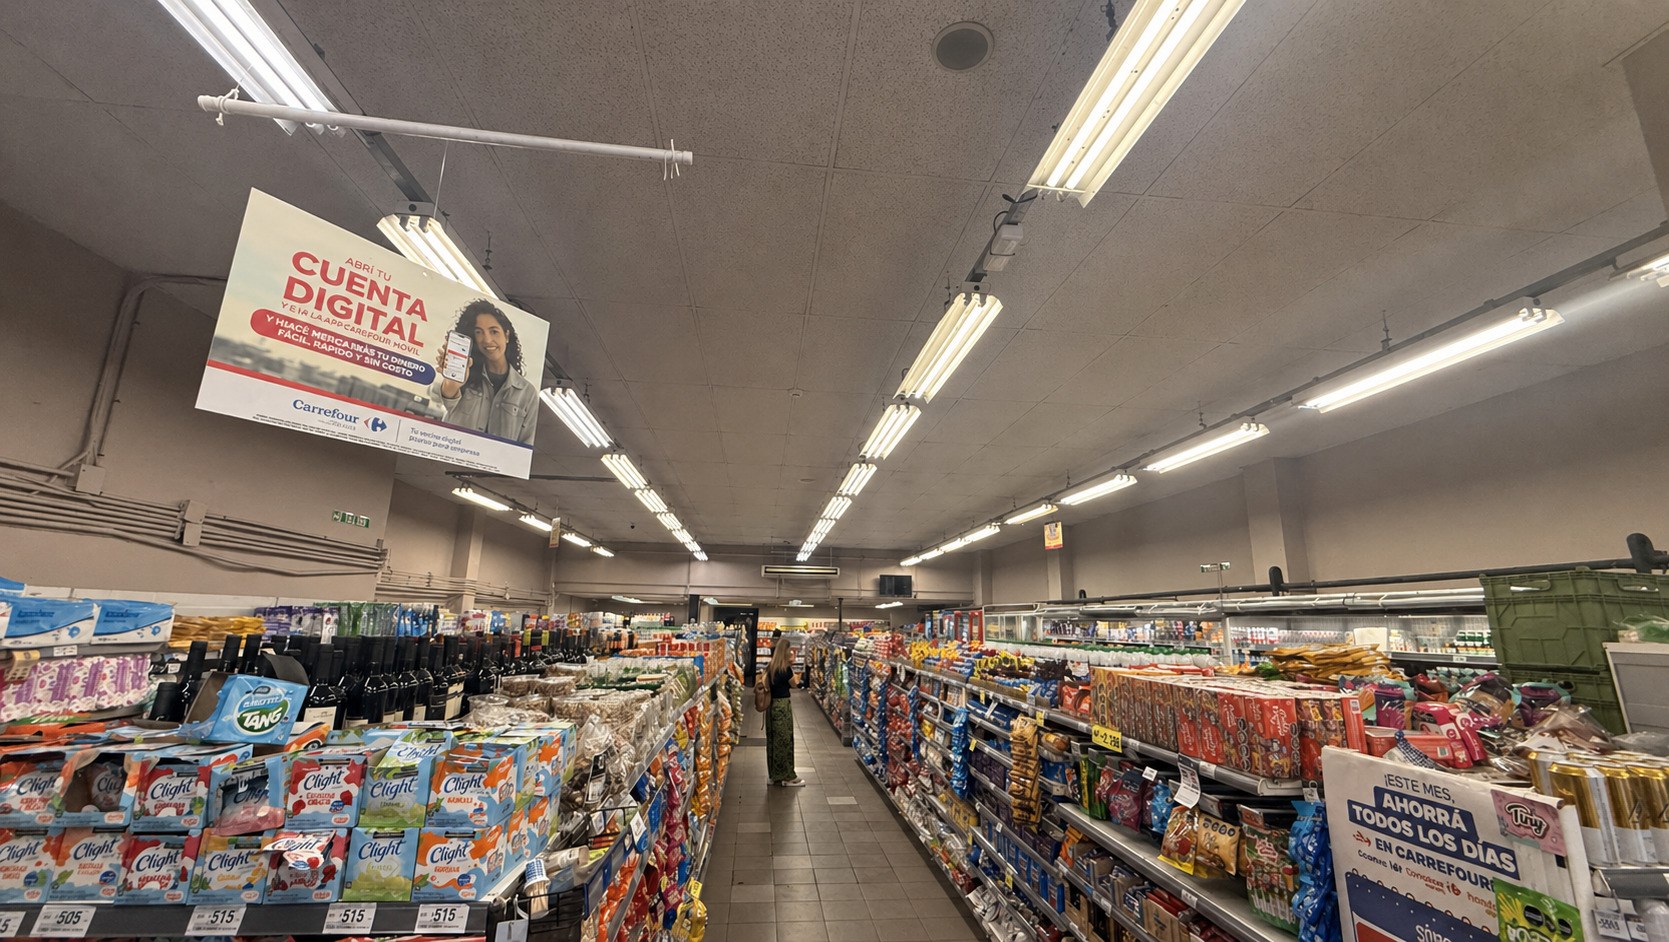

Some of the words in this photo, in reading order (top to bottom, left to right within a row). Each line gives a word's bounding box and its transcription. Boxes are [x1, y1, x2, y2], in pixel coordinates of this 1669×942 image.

[345, 258, 375, 275] ABRÍ
[376, 269, 392, 282] TU
[292, 252, 428, 322] CUENTA
[283, 276, 424, 348] DIGITAL
[265, 314, 274, 322] Y
[376, 350, 390, 364] TU
[354, 352, 363, 361] Y
[364, 356, 381, 368] SIN
[381, 360, 414, 378] COSTO
[292, 398, 360, 424] Carrefour
[242, 707, 283, 730] TANG
[16, 776, 56, 796] Cligh
[150, 778, 195, 800] Clight
[304, 770, 344, 790] Clight
[370, 777, 418, 800] Clight
[444, 774, 486, 795] Clight
[1384, 774, 1421, 793] ¡ESTE
[1422, 782, 1455, 804] MES,
[1382, 792, 1468, 833] AHORRÁ
[1506, 802, 1550, 837] Tiny
[73, 836, 118, 862] Clight
[358, 838, 407, 862] Clight
[1352, 804, 1414, 838] TODOS
[1417, 824, 1457, 853] LOS
[1461, 838, 1517, 874] DÍAS
[1374, 838, 1393, 855] EN
[136, 850, 181, 874] Clight
[208, 850, 252, 874] Clight
[430, 842, 470, 864] Clight
[57, 910, 83, 925] 505
[210, 910, 236, 924] 515
[342, 909, 366, 923] 515
[434, 908, 457, 922] 515
